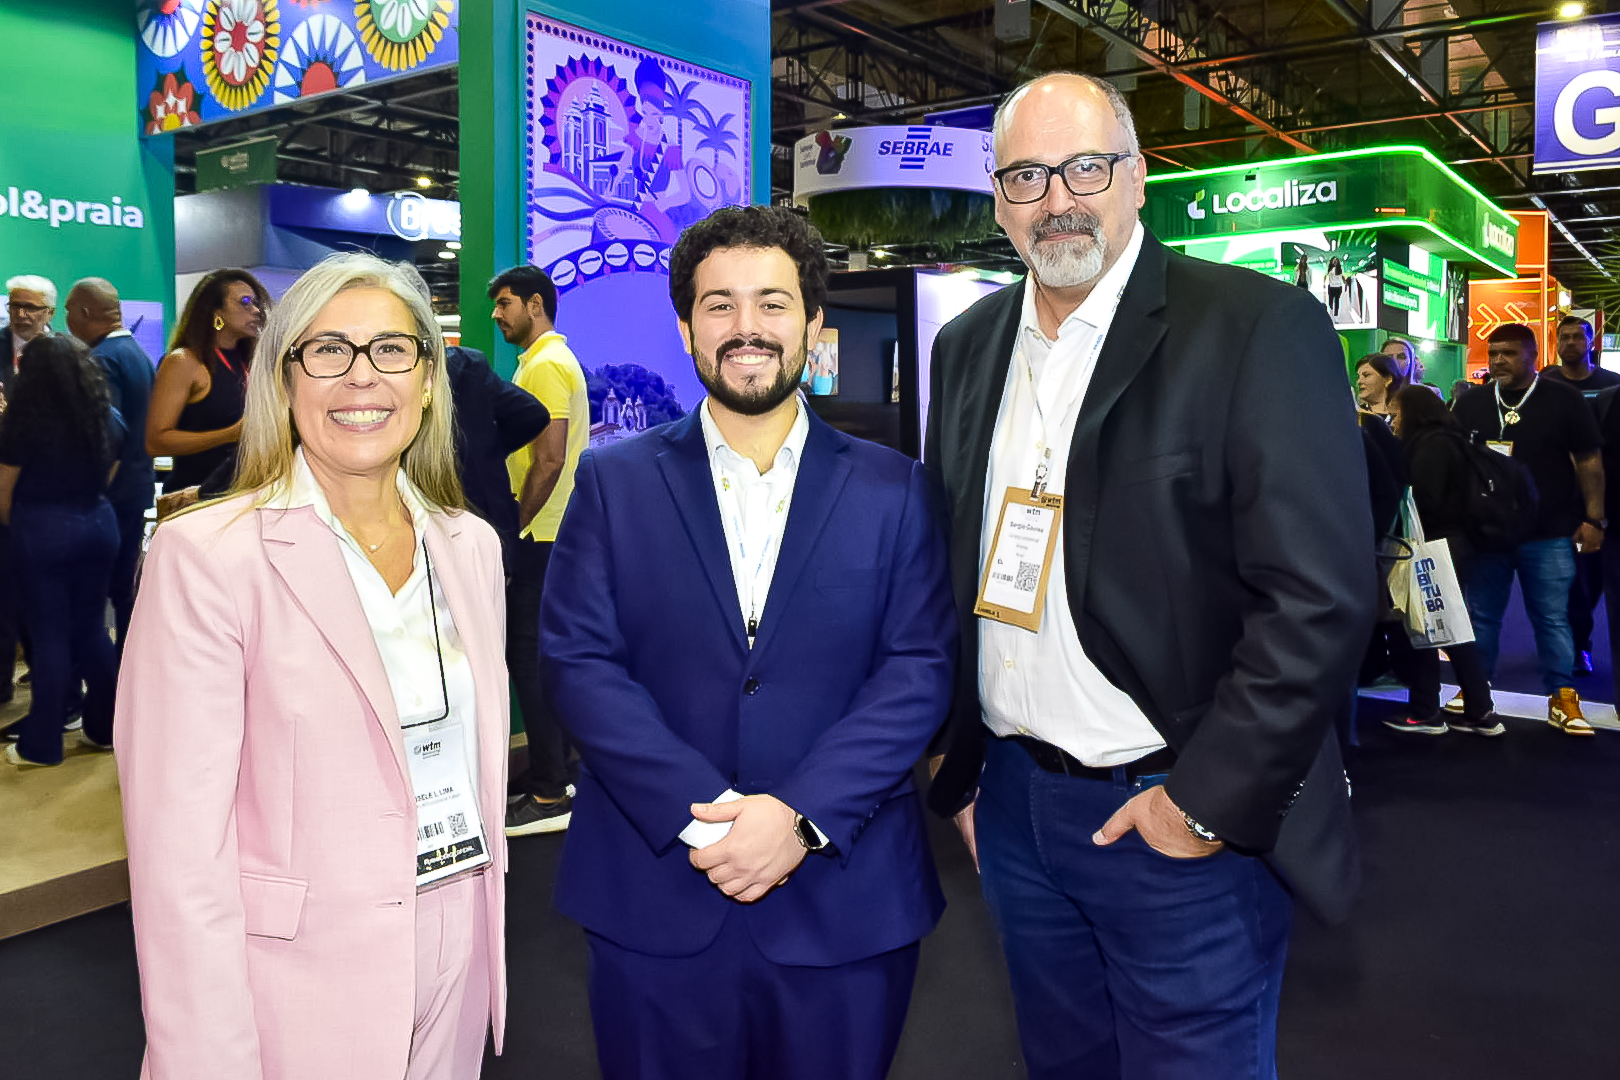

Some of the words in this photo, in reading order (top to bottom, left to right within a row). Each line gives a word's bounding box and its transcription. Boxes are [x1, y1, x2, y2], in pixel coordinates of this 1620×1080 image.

[1553, 69, 1620, 156] G
[878, 140, 954, 157] SEBRAE
[1212, 179, 1337, 214] Localiza
[1426, 598, 1445, 612] BA
[422, 741, 442, 752] wtm
